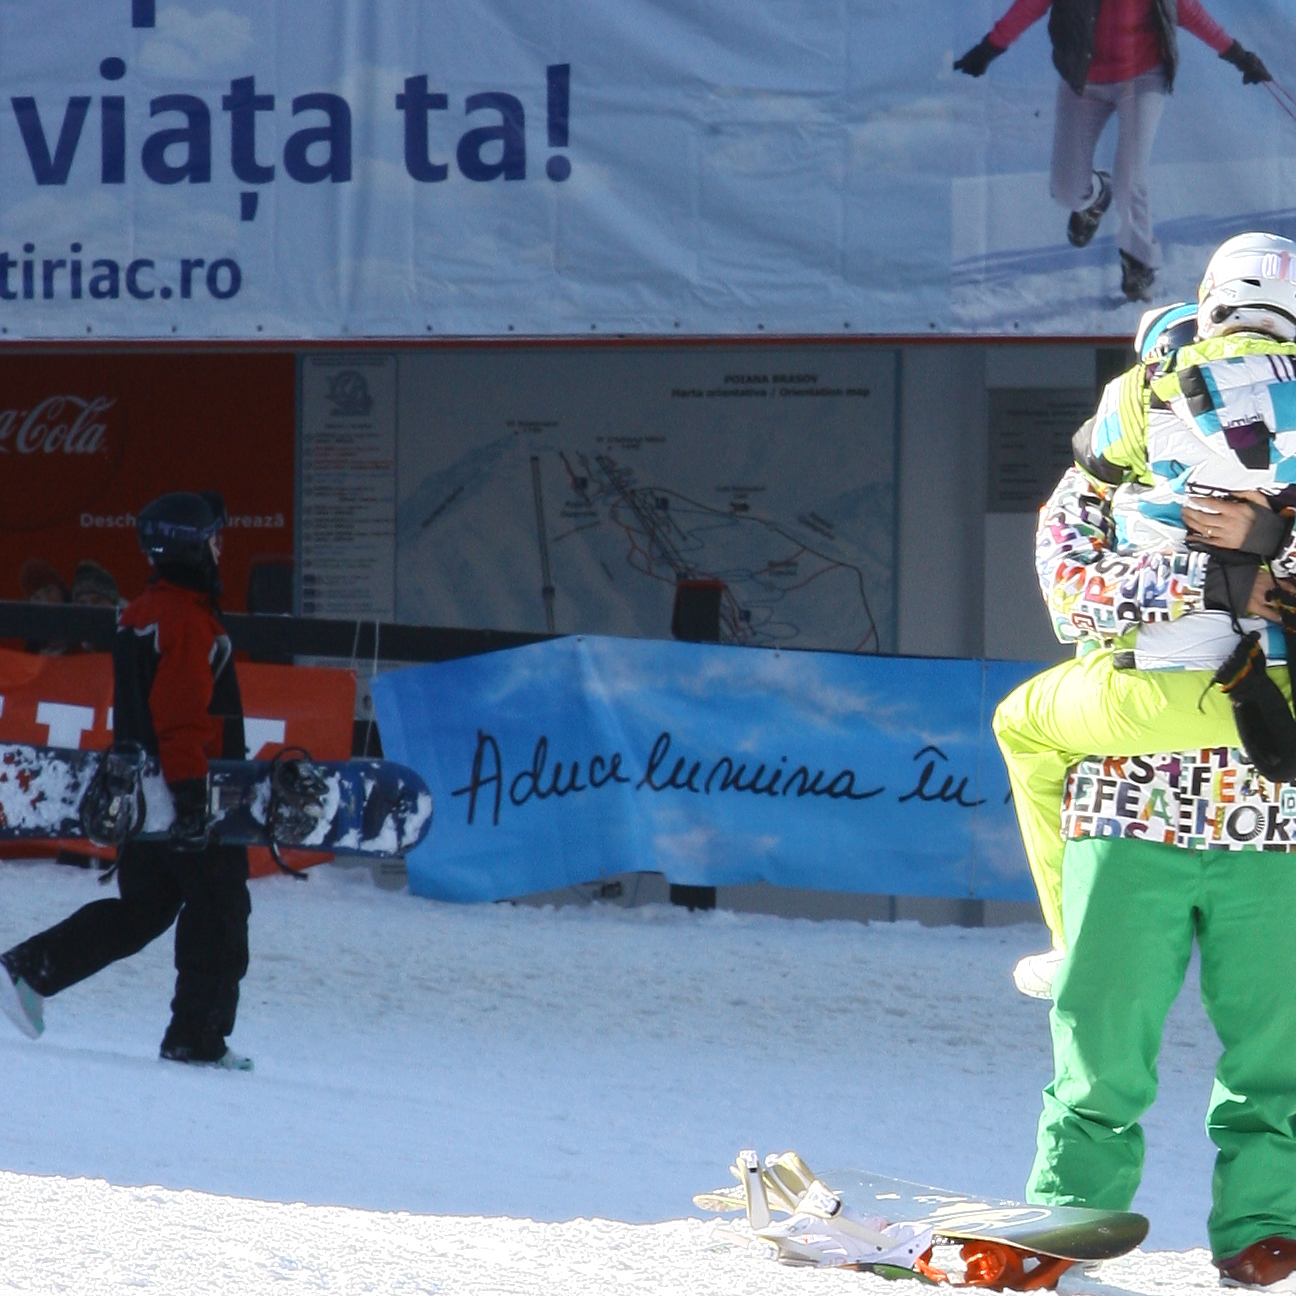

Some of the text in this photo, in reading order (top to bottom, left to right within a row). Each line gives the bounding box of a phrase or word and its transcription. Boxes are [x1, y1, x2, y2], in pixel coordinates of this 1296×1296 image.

[395, 63, 573, 183] ta!
[0, 241, 243, 301] tiriac.ro
[636, 732, 884, 801] lumina
